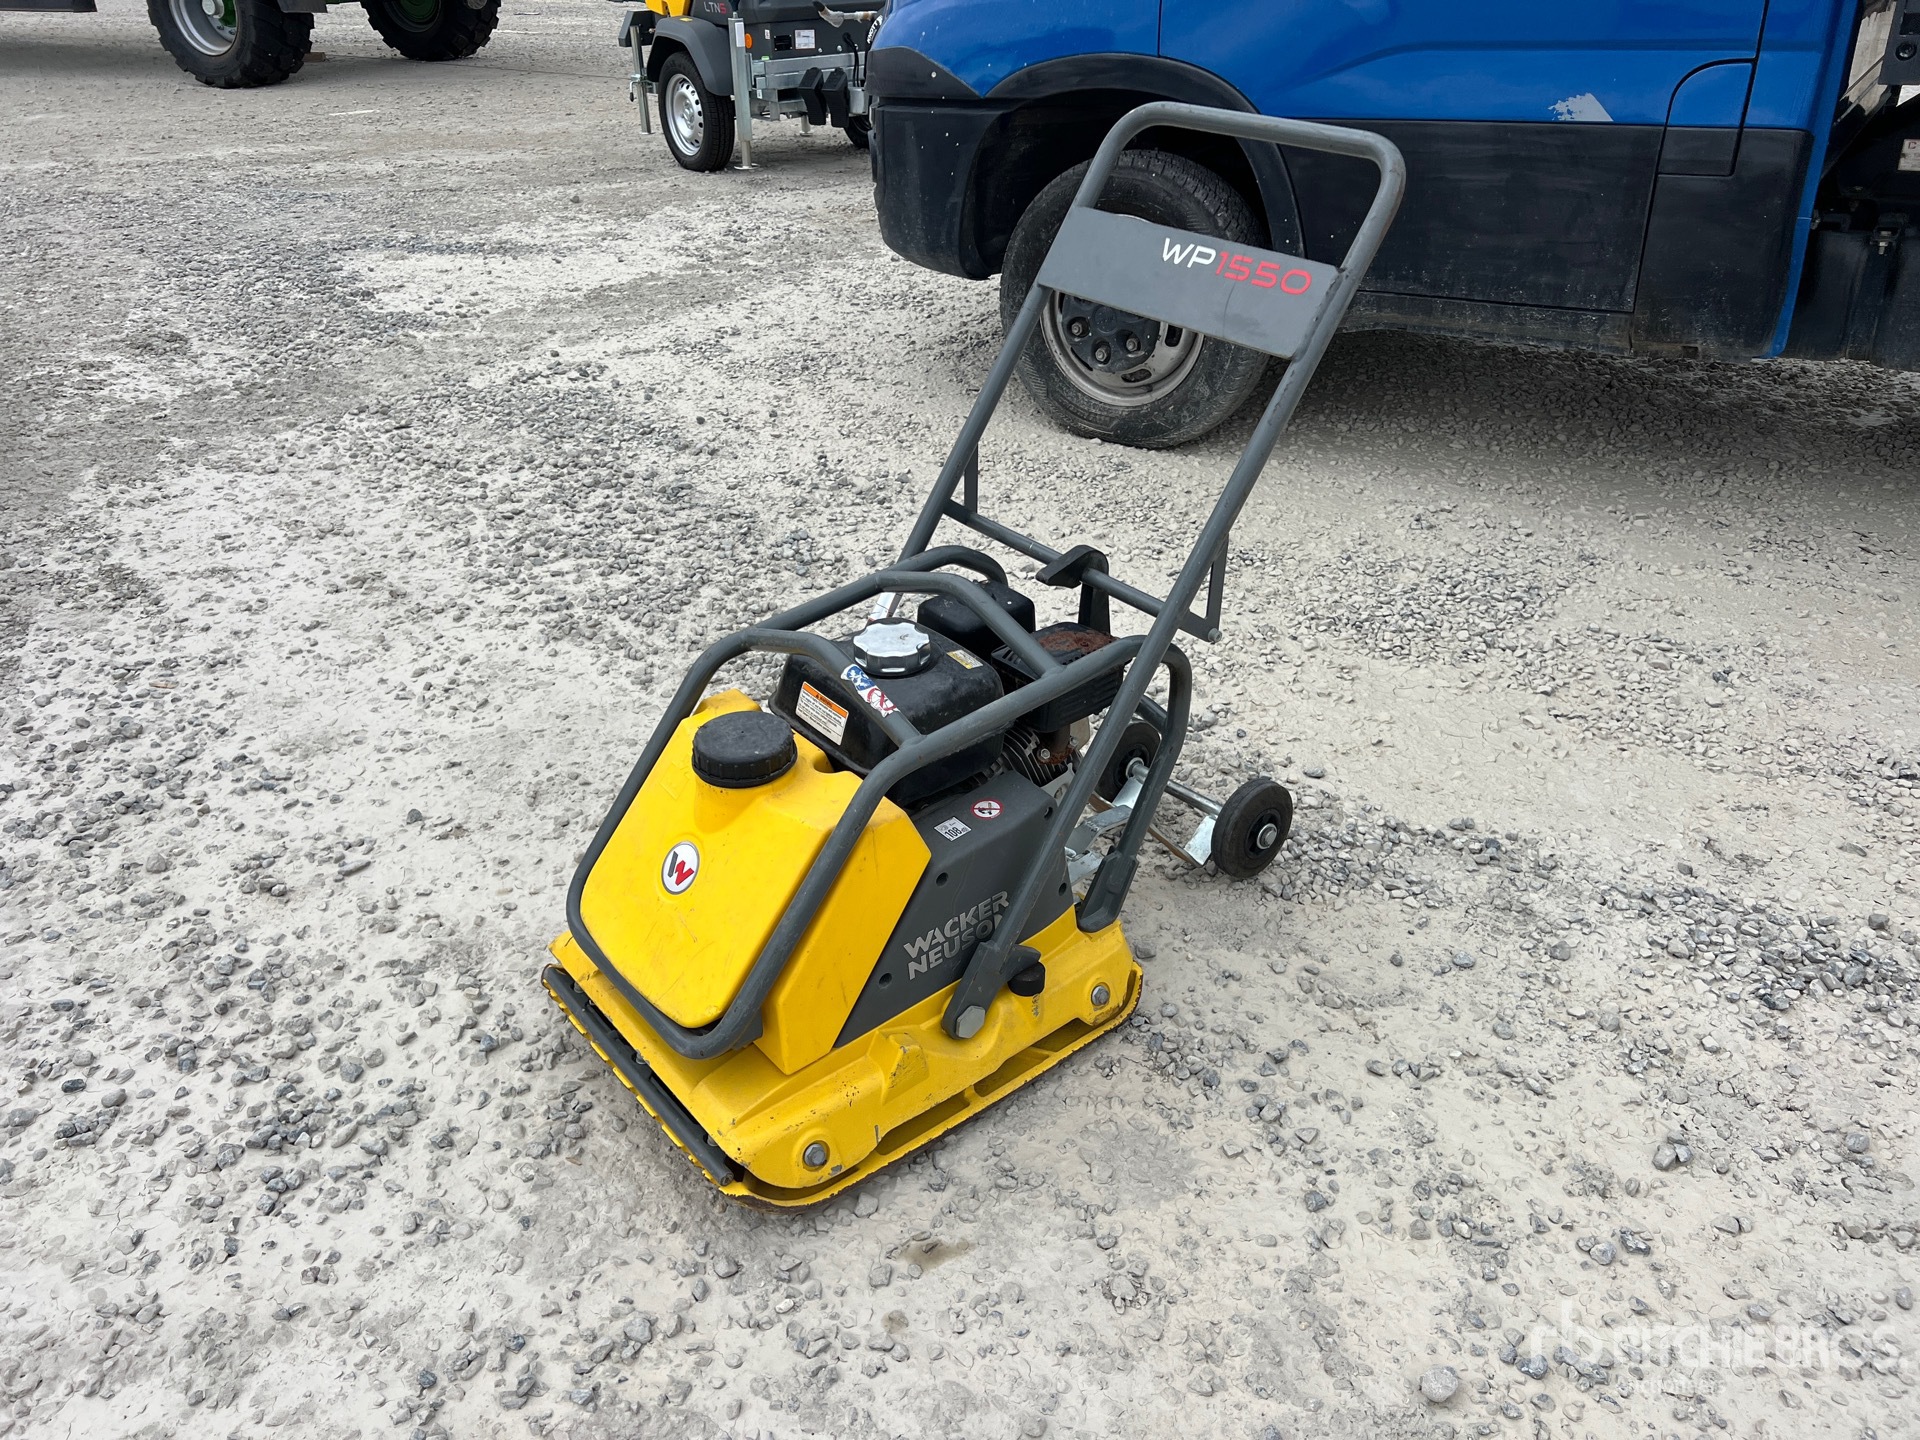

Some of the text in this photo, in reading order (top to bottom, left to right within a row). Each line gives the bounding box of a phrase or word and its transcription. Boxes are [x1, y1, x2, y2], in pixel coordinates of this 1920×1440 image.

[1162, 237, 1313, 296] WP1550
[944, 827, 962, 839] 108
[903, 890, 1009, 959] WACKER
